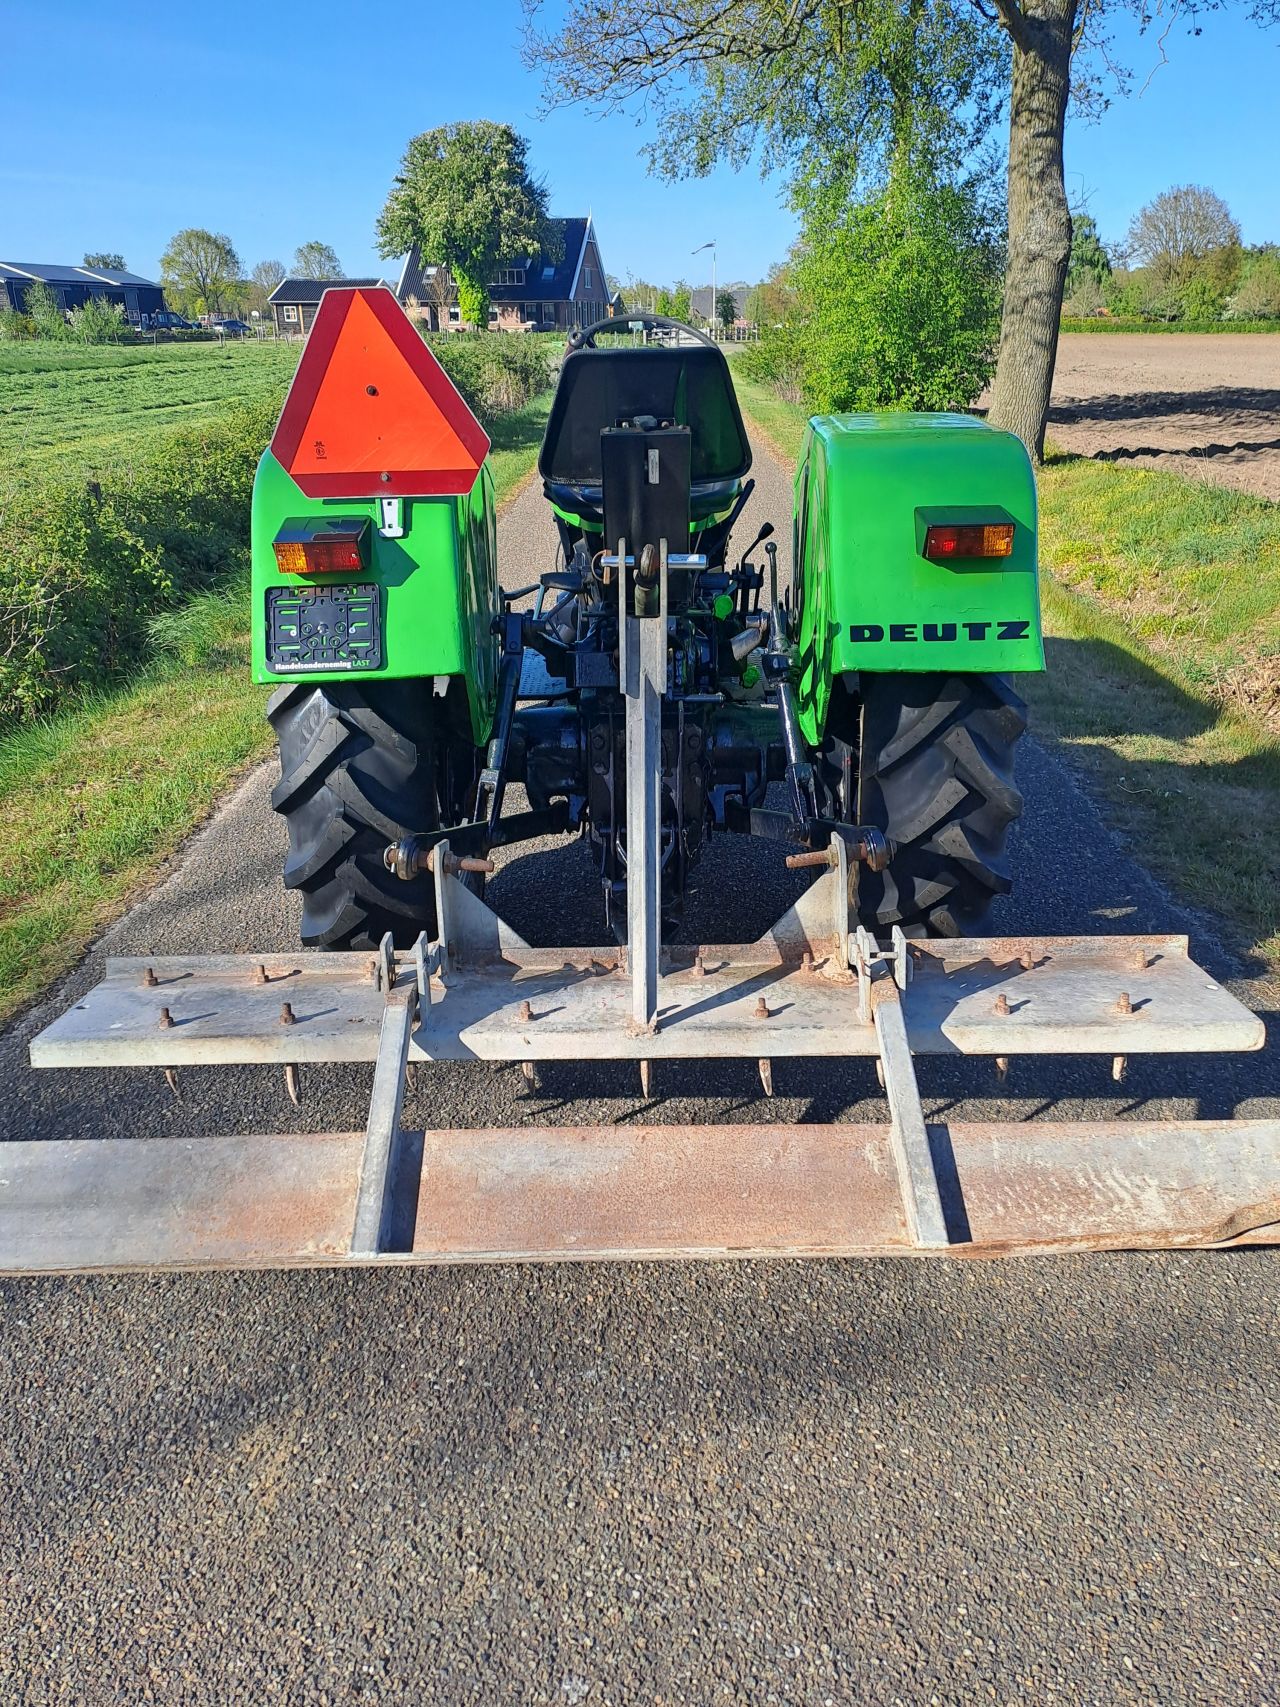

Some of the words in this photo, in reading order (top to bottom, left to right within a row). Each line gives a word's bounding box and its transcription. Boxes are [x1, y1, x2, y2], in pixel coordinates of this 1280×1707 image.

[850, 621, 1030, 642] DEUTZ
[275, 660, 352, 670] Handelsonderneming
[352, 659, 370, 667] LAST
